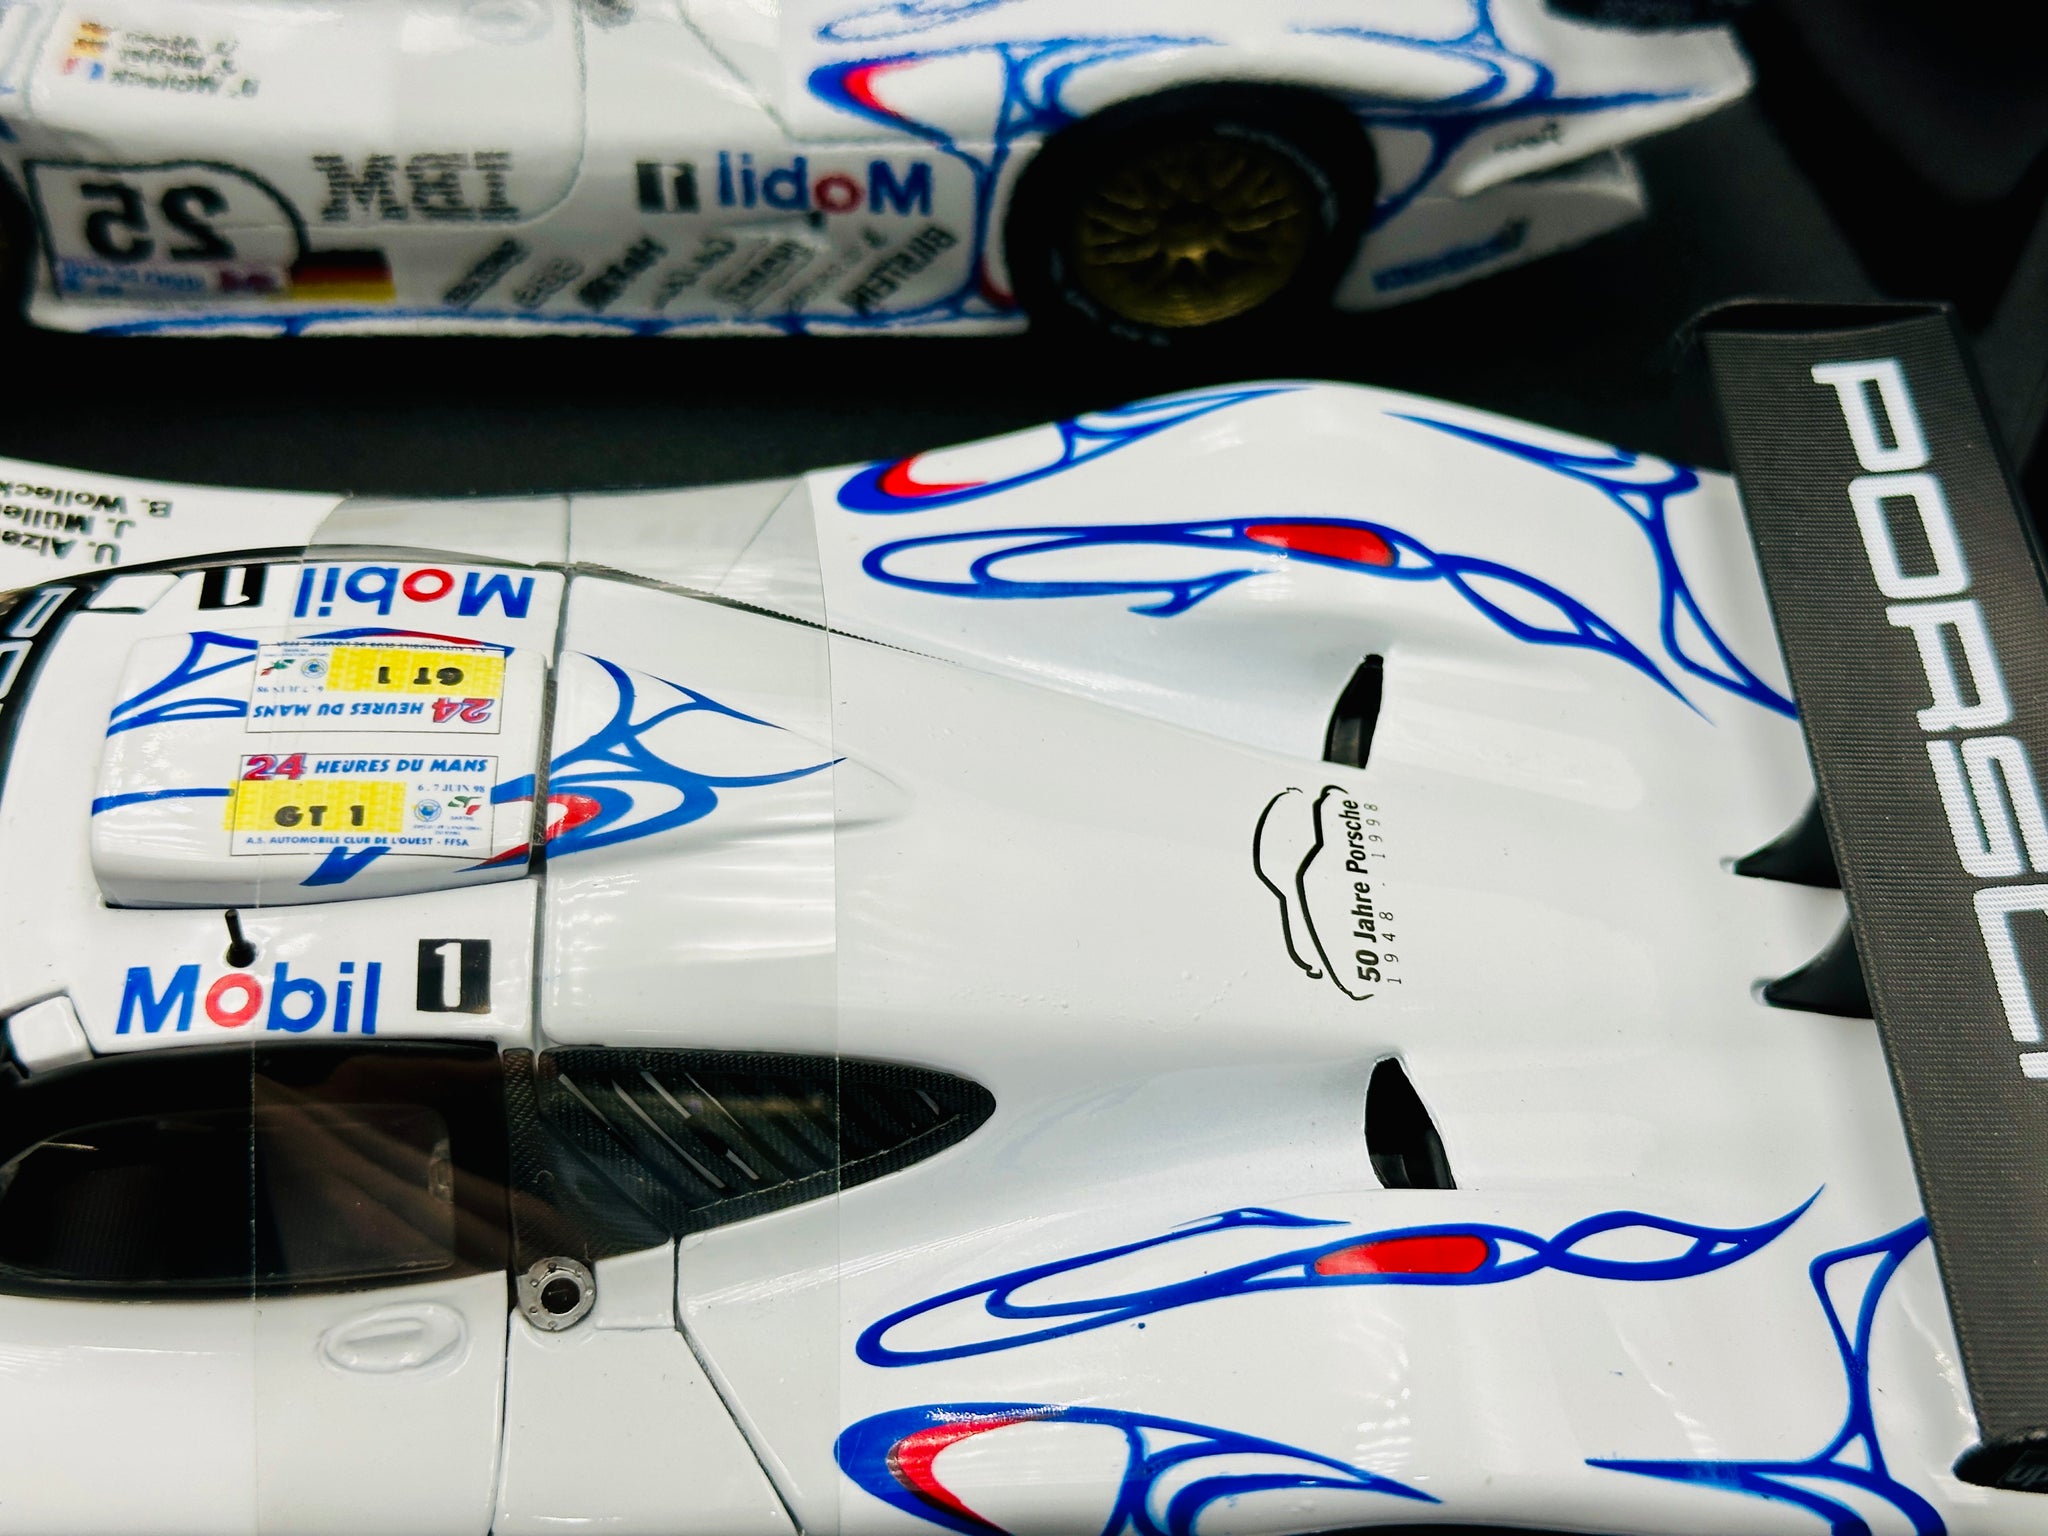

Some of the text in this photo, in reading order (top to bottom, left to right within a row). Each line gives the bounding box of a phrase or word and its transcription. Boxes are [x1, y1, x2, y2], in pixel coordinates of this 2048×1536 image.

[0, 504, 136, 539] J. Mülle
[140, 497, 174, 519] B.
[0, 530, 121, 566] U. Alze
[294, 567, 536, 619] Mobil
[378, 666, 464, 686] GT 1
[253, 697, 495, 723] 24 HEURES DU MANS
[1811, 357, 2048, 1080] PORSC
[242, 752, 488, 780] 24 HEURES DU MANS
[274, 805, 365, 827] GT 1
[270, 836, 340, 845] AUTOMOBILE
[343, 836, 371, 845] CLUB
[374, 836, 388, 845] DE
[392, 836, 433, 846] L'OUEST
[1338, 799, 1382, 983] 50 Jahre Porsche
[115, 961, 382, 1035] Mobil
